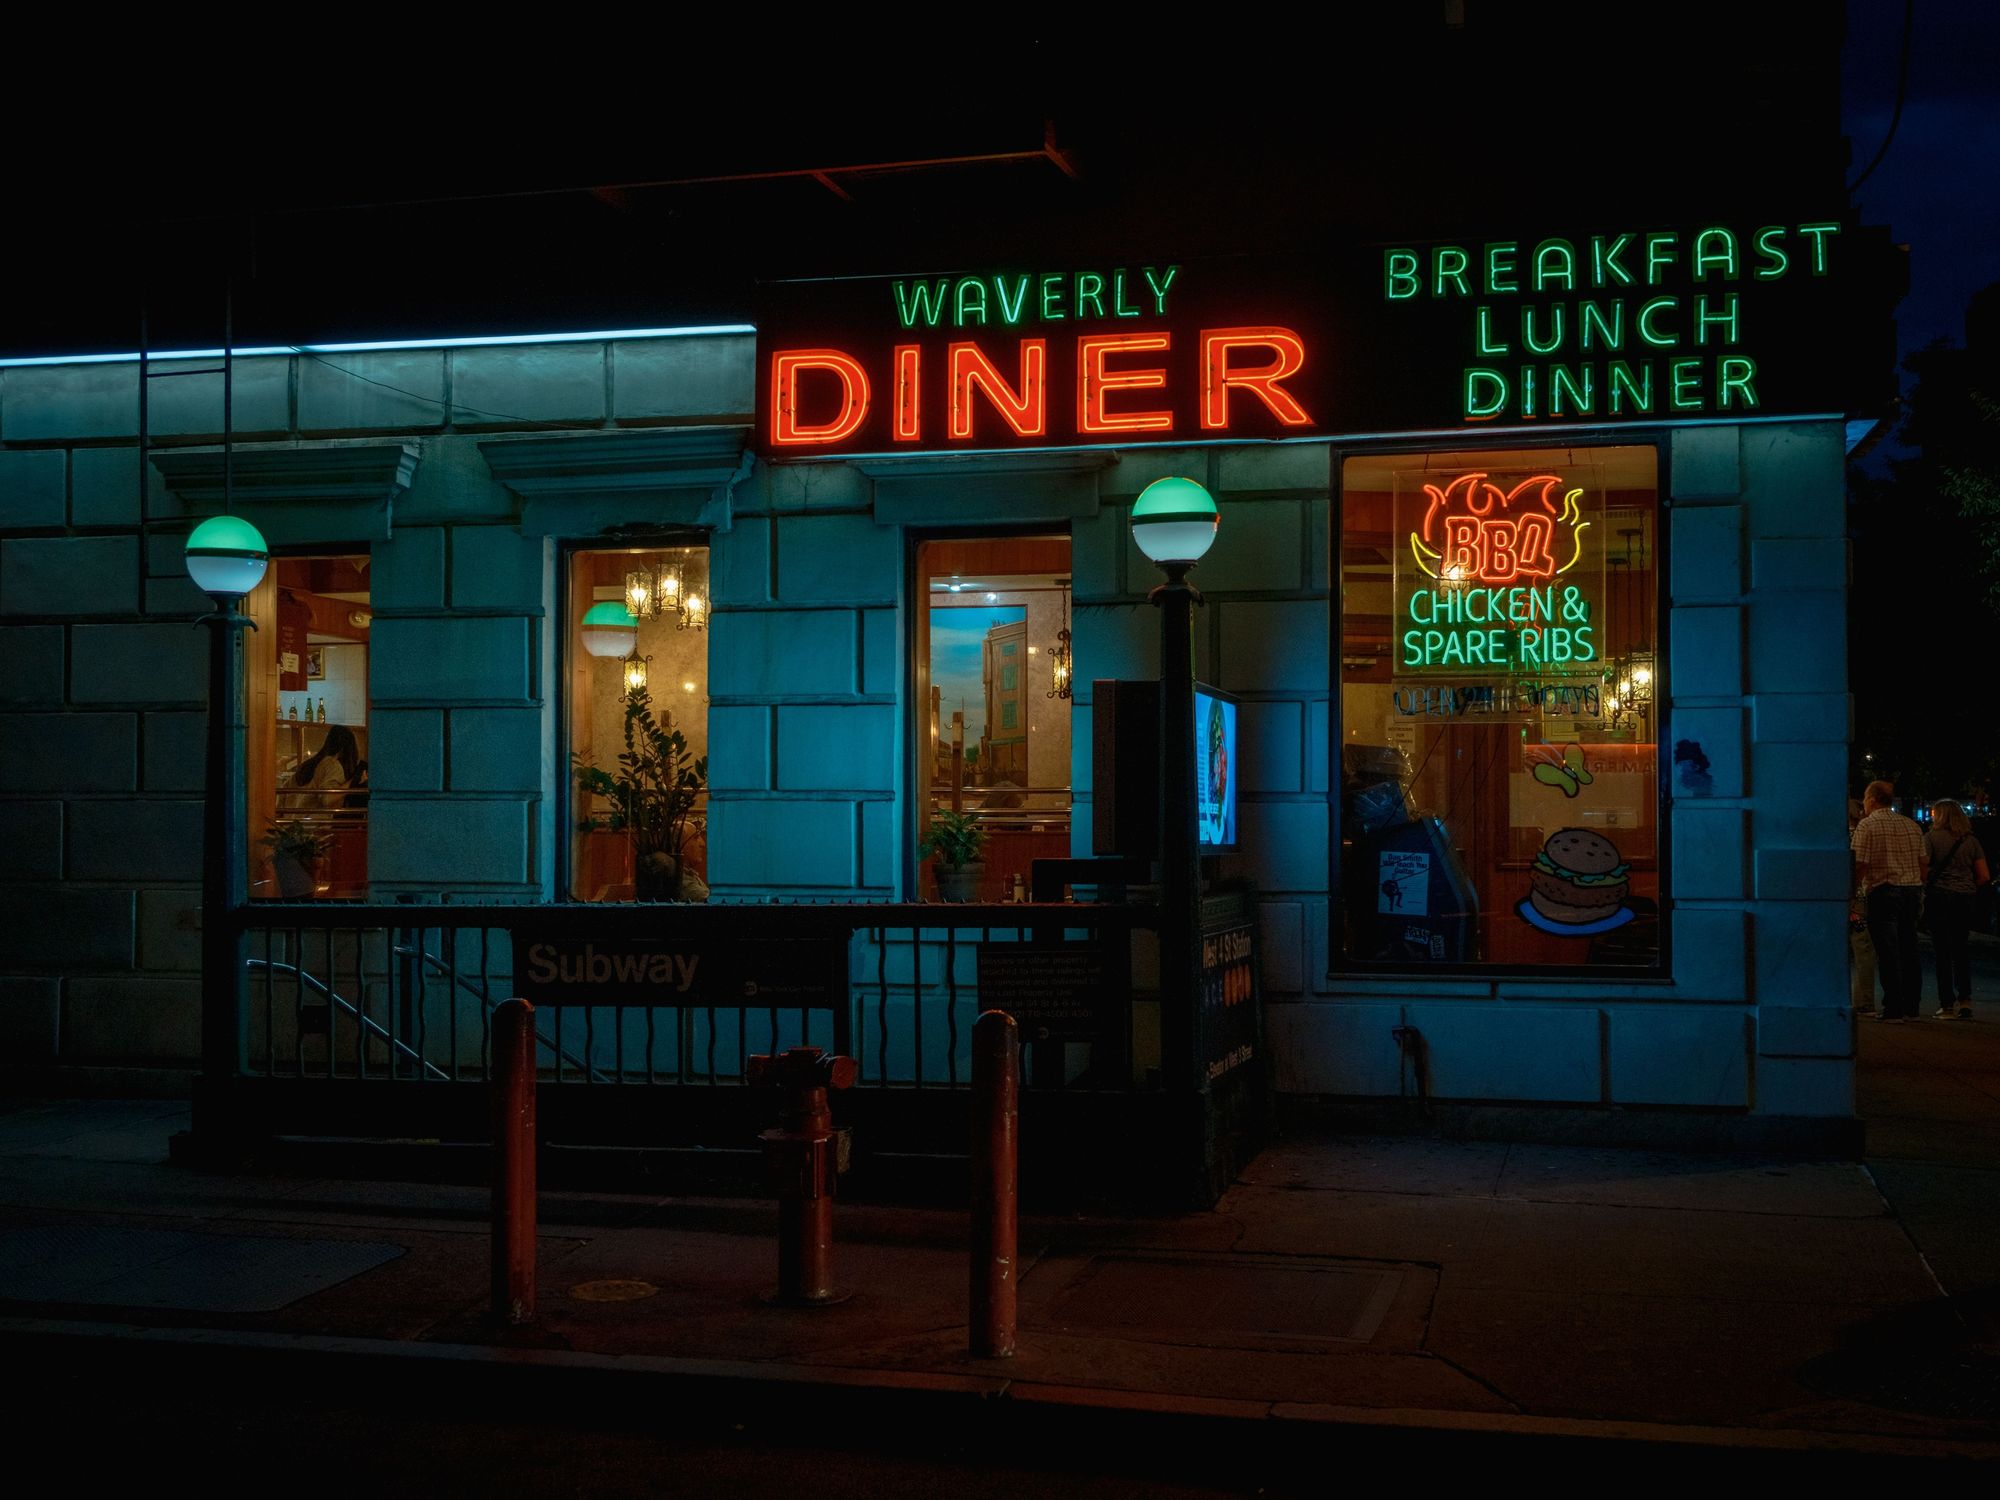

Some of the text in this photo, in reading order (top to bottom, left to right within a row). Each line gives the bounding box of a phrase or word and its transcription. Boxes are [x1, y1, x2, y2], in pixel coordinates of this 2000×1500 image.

[1384, 221, 1843, 301] BREAKFAST
[892, 264, 1183, 329] WAVERLY
[1476, 293, 1741, 357] LUNCH
[769, 325, 1316, 447] DINER
[1463, 355, 1760, 421] DINNER
[1440, 512, 1555, 581] BBQ
[1409, 585, 1588, 625] CHICKEN &
[1403, 626, 1596, 667] SPARE RIBS
[527, 943, 700, 993] Subway
